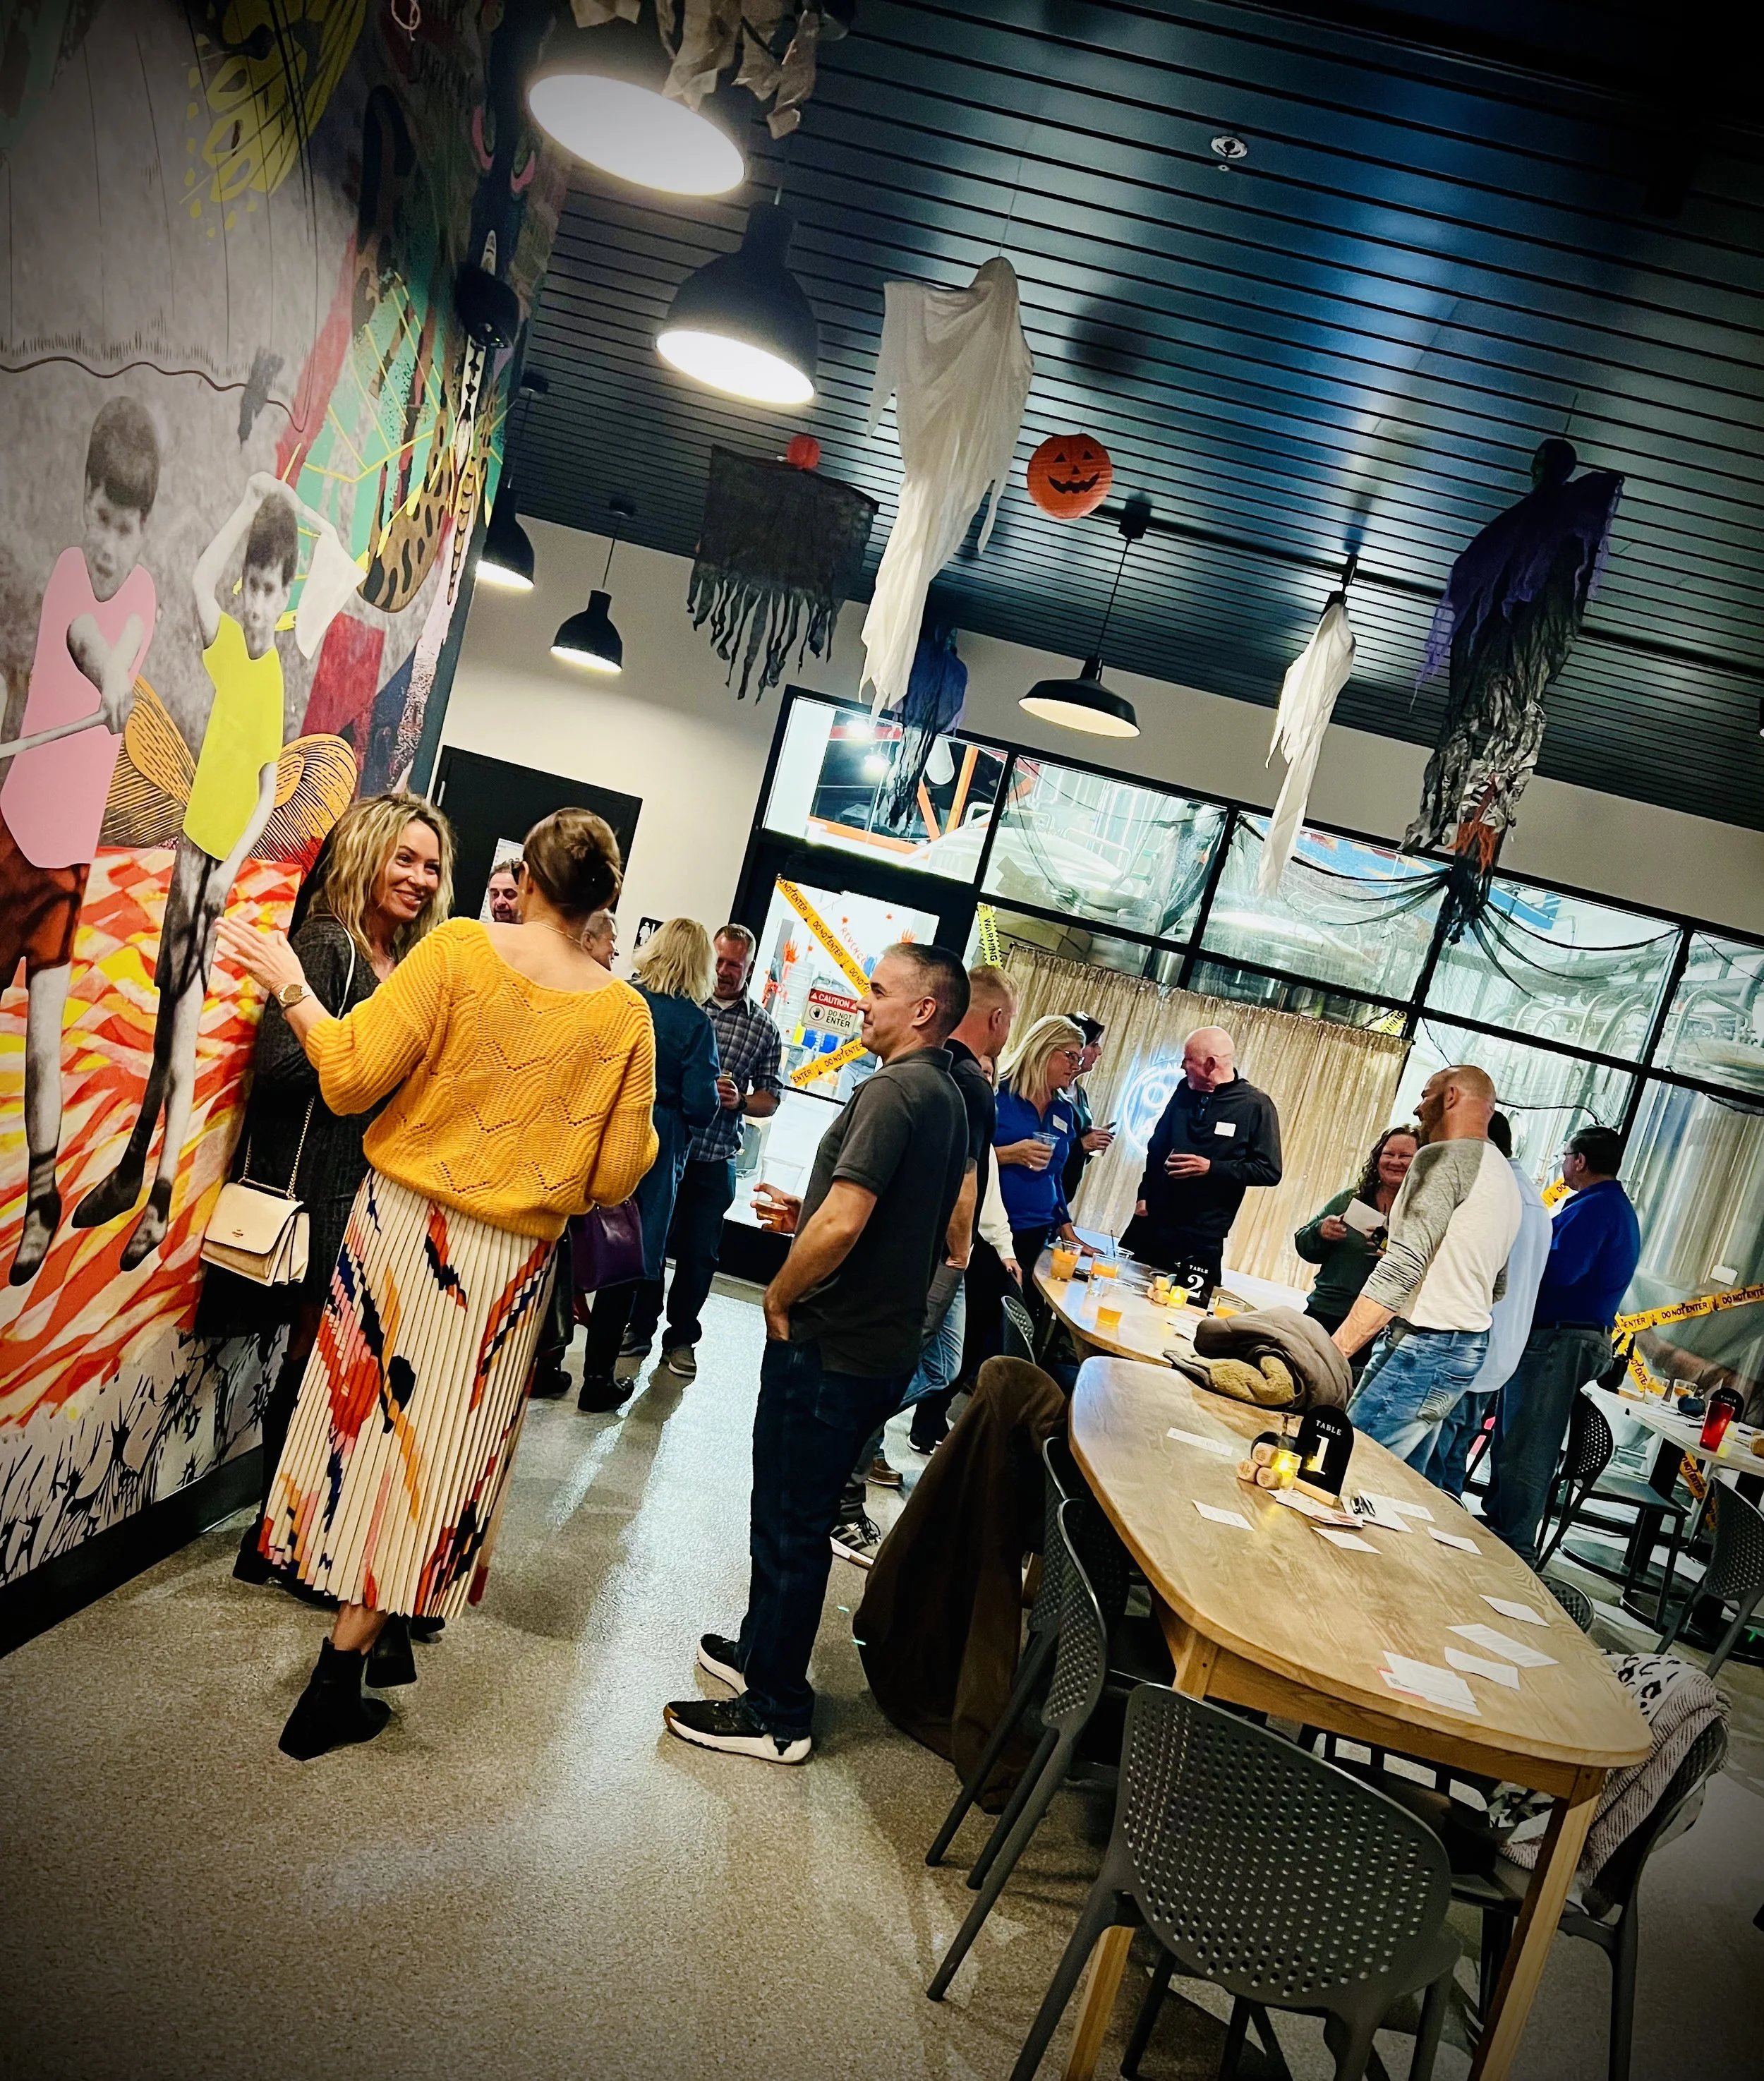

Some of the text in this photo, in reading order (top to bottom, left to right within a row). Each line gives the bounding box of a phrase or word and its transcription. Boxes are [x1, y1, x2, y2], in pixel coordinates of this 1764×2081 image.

[783, 882, 797, 895] NOT
[791, 893, 807, 912] ENTER
[813, 921, 843, 958] DO NOT ENTER
[984, 917, 998, 962] WARNING
[850, 967, 858, 977] DO
[855, 975, 869, 988] NOT
[818, 993, 850, 1008] CAUTION
[826, 1015, 851, 1028] ENTER
[839, 1013, 852, 1021] NOT
[792, 1069, 812, 1083] ENTER
[824, 1058, 833, 1067] DO
[833, 1048, 845, 1062] NOT
[1189, 1265, 1209, 1274] TABLE
[1187, 1274, 1204, 1298] 2
[1624, 1317, 1645, 1329] ENTER
[1672, 1303, 1686, 1316] NOT
[1685, 1302, 1708, 1313] ENTER
[1722, 1296, 1732, 1305] DO
[1732, 1288, 1746, 1302] NOT
[1746, 1288, 1764, 1299] ENTE
[1635, 1368, 1648, 1387] ENTE
[1316, 1420, 1342, 1436] TABLE
[1310, 1435, 1330, 1475] 1
